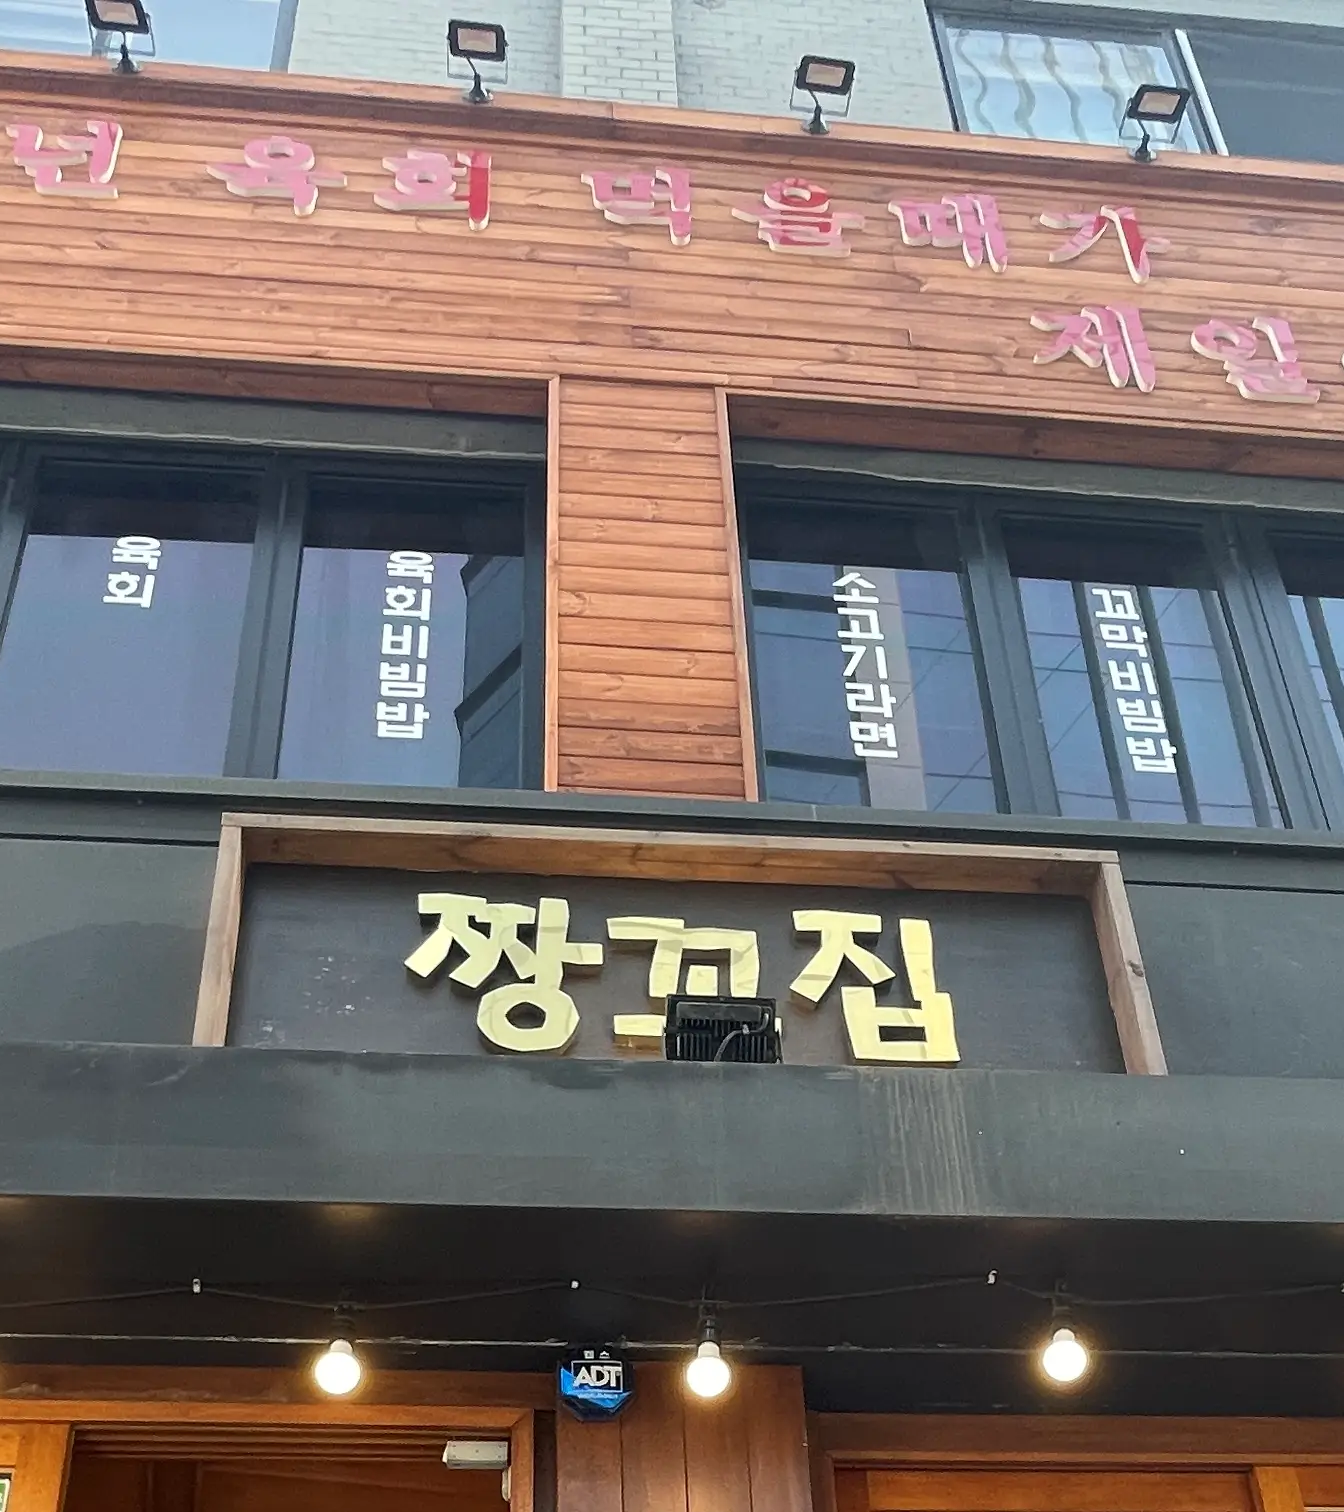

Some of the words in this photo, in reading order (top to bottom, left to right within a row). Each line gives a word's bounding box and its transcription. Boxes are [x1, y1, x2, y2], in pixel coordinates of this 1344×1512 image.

[206, 135, 492, 231] 육회
[103, 535, 162, 609] 육회
[376, 550, 435, 740] 육회비빔밥
[832, 571, 899, 759] 소고기라면
[1091, 588, 1178, 774] 꼬막비빔밥
[403, 893, 960, 1063] 짱꼬집
[573, 1365, 623, 1387] ADT
